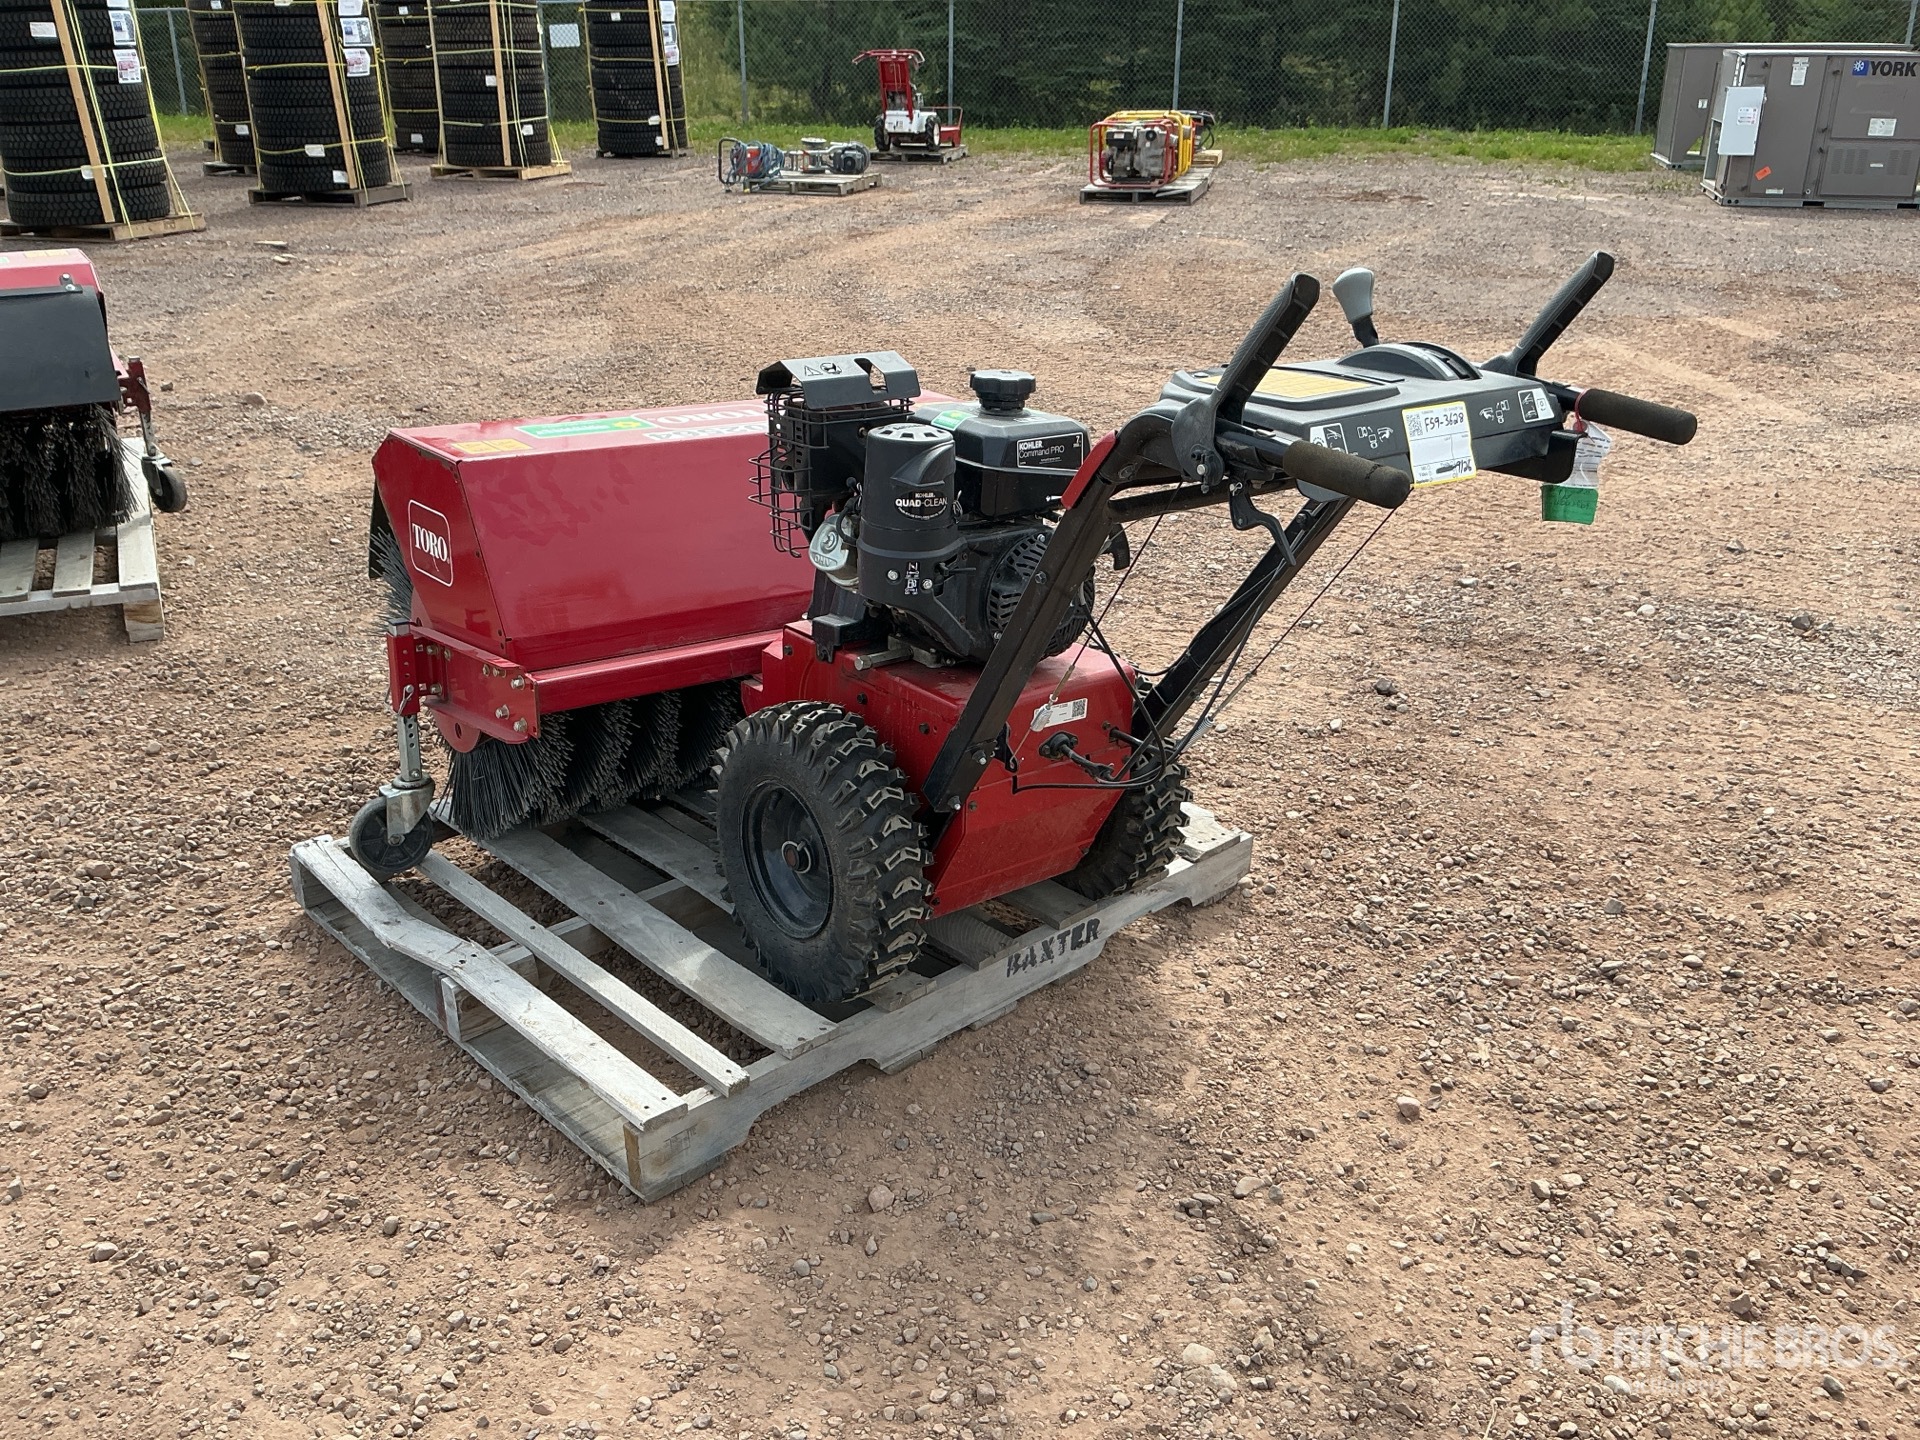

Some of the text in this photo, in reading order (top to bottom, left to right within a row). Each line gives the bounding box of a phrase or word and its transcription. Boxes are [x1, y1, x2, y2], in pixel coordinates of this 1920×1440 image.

[1870, 61, 1918, 77] YORK
[656, 409, 766, 424] TORO
[1424, 412, 1464, 433] F59-3628
[1019, 440, 1044, 451] KOHLER
[1019, 447, 1050, 459] Command
[1050, 444, 1065, 454] PRO
[895, 497, 948, 508] QUAD-CLEAN
[411, 522, 449, 563] TORO
[1006, 917, 1101, 978] BAXTER
